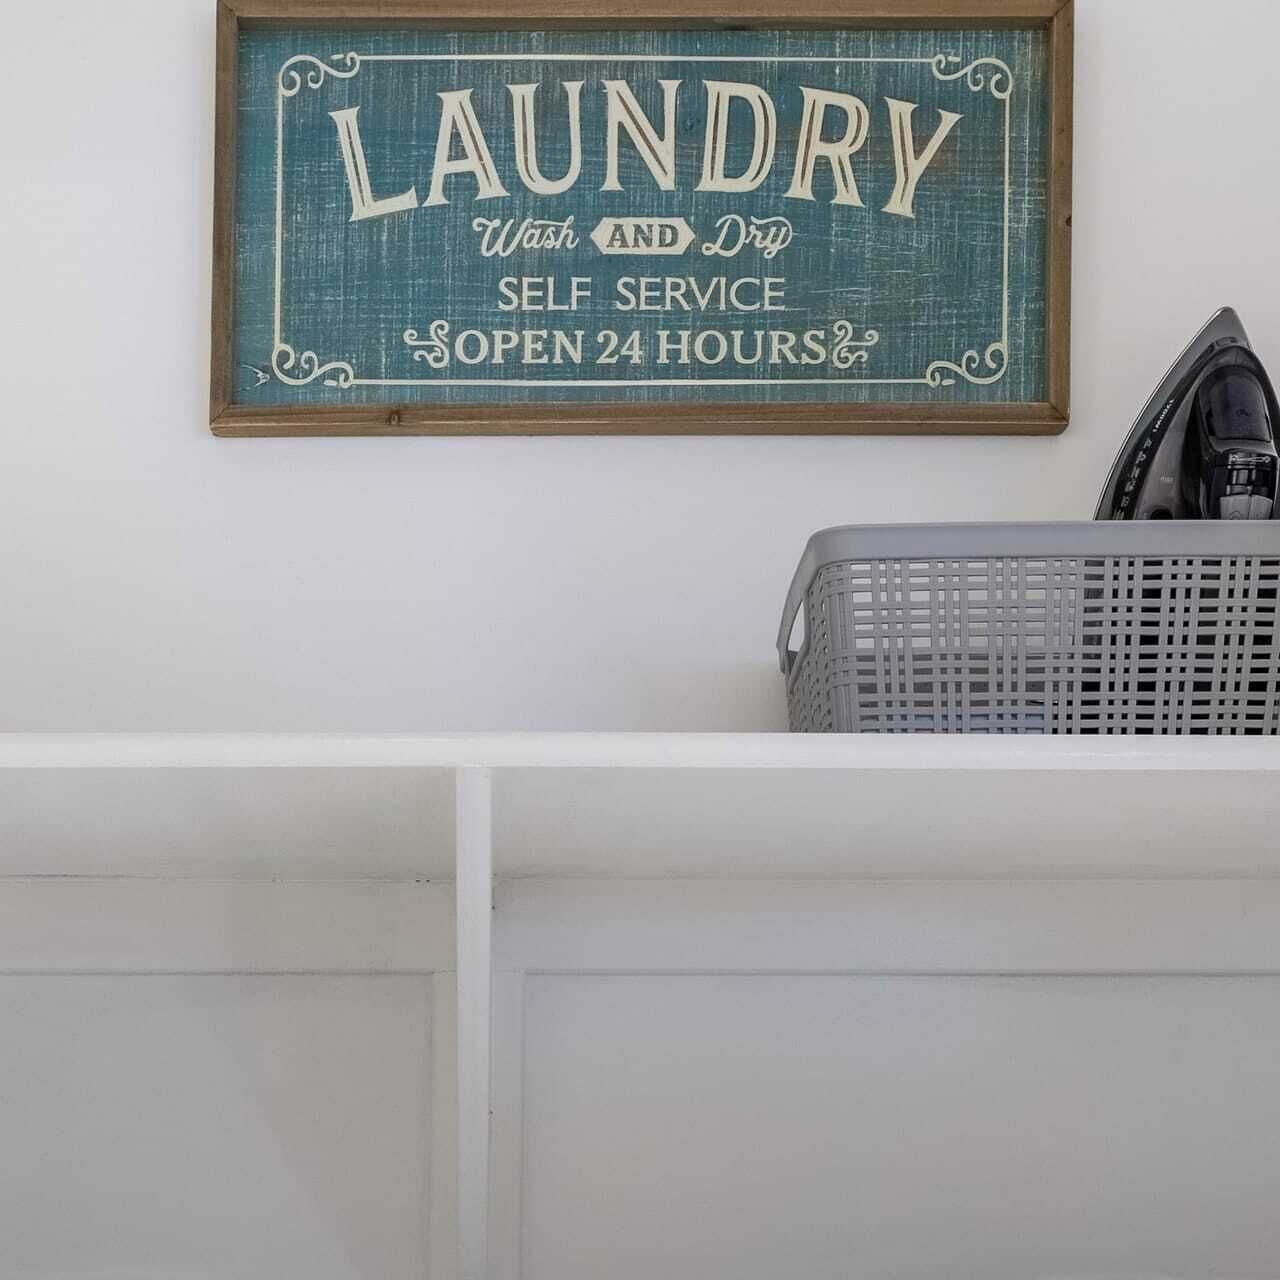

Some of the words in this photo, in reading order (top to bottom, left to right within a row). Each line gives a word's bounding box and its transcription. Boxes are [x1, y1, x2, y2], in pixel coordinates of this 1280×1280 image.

[327, 79, 964, 221] LAUNDRY
[473, 216, 580, 258] Wash
[606, 223, 680, 250] AND
[701, 214, 794, 259] Dry
[498, 277, 592, 312] SELF
[615, 276, 786, 311] SERVICE
[454, 330, 588, 365] OPEN
[596, 329, 644, 365] 24
[657, 329, 825, 365] HOURS
